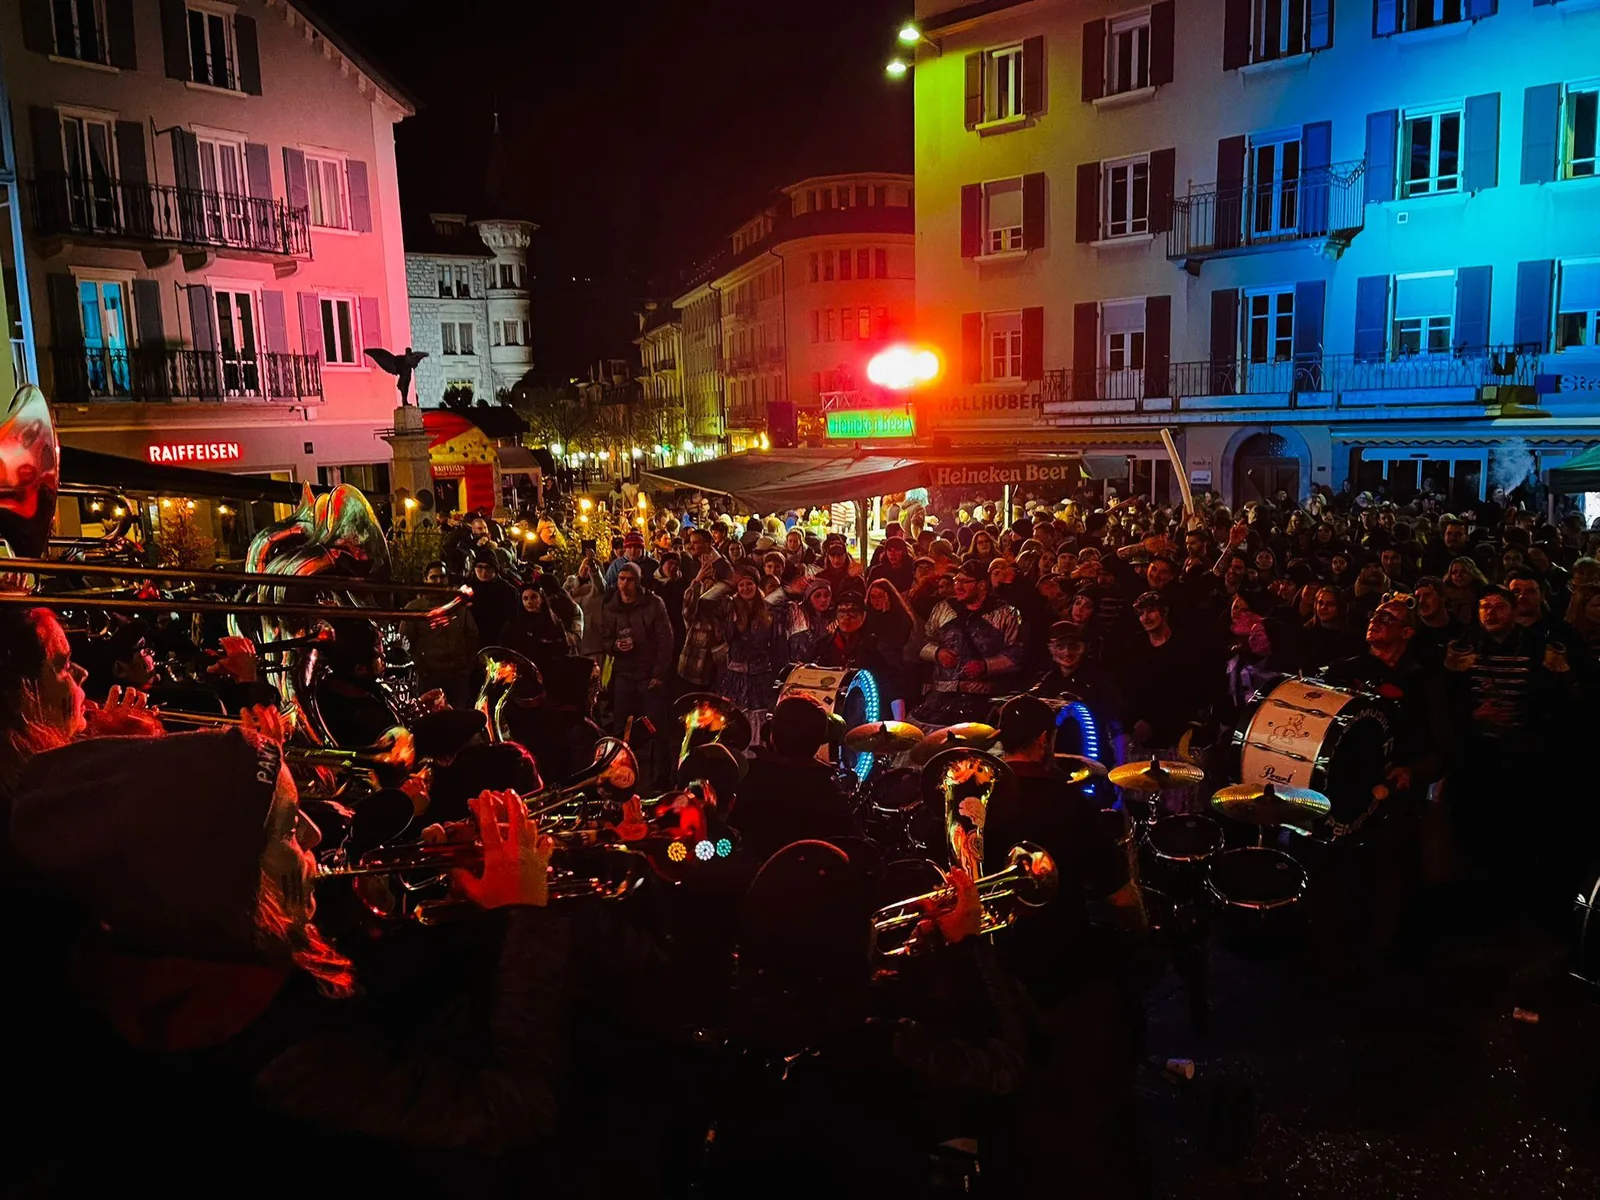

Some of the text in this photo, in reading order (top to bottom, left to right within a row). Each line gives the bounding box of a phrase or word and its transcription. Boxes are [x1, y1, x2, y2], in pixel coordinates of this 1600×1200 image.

[831, 413, 908, 435] Heineken Beer
[149, 442, 239, 462] RAIFFEISEN
[937, 463, 1069, 485] Heineken Beer
[1259, 764, 1293, 784] Pearl
